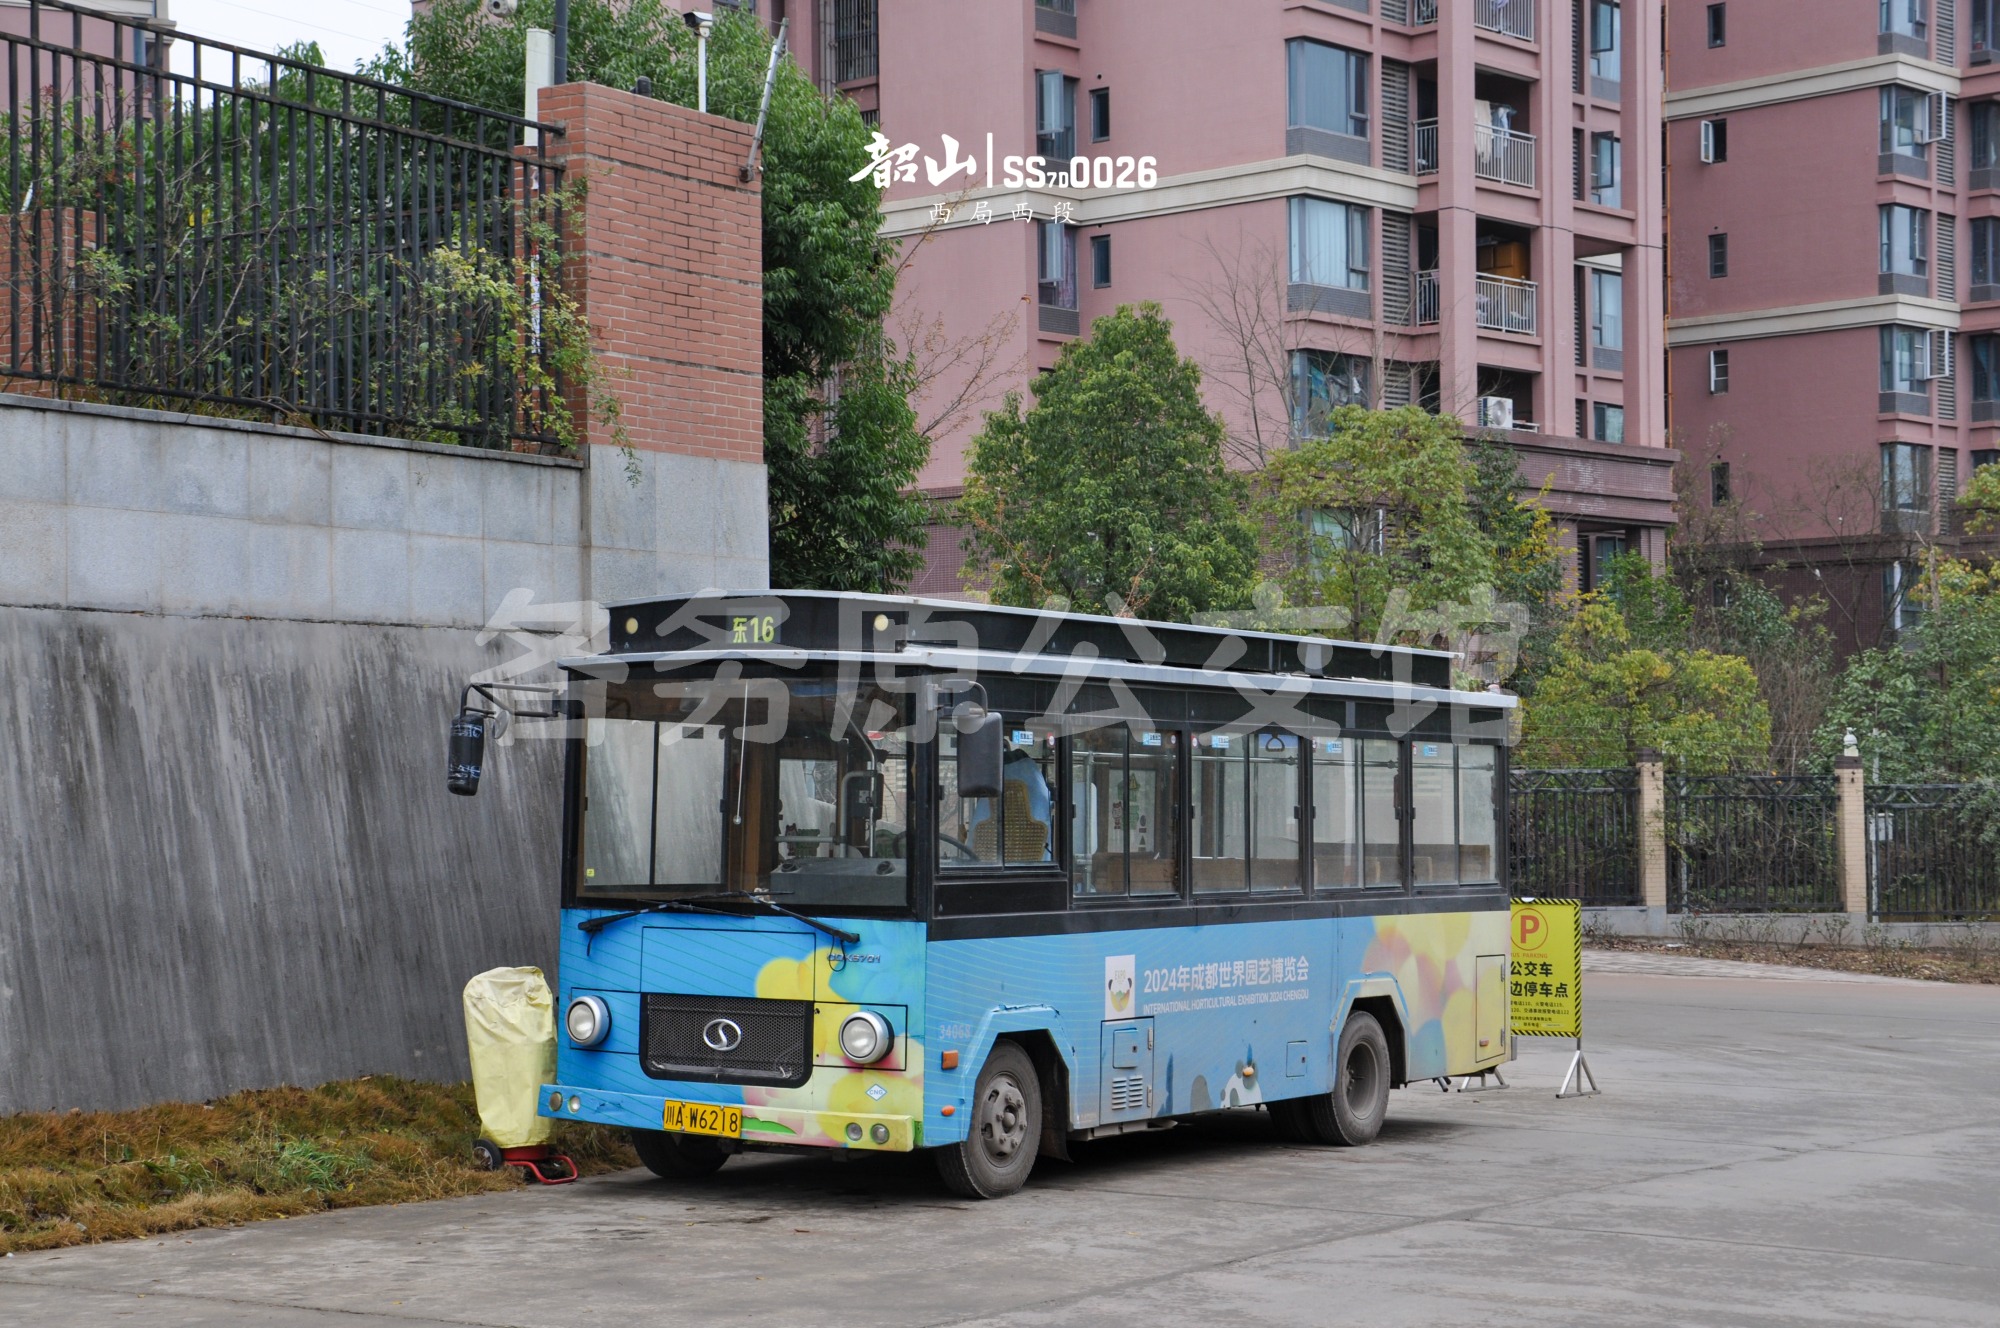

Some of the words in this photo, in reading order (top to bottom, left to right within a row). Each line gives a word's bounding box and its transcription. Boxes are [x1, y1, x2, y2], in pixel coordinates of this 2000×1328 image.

[733, 616, 775, 643] 东16
[1520, 915, 1540, 944] P
[1144, 955, 1310, 993] 2024年成都世界园艺博览会
[1511, 961, 1553, 977] 公交车
[1511, 981, 1568, 998] 边停车点
[1143, 1001, 1191, 1015] INTERNATIONAL
[1191, 996, 1238, 1010] HORTICULTURAL
[1238, 992, 1269, 1005] EXHIBITION
[1269, 991, 1284, 1002] 2024
[1283, 989, 1310, 1001] CHENGDU
[940, 1024, 971, 1039] 34068
[869, 1088, 883, 1096] CNG
